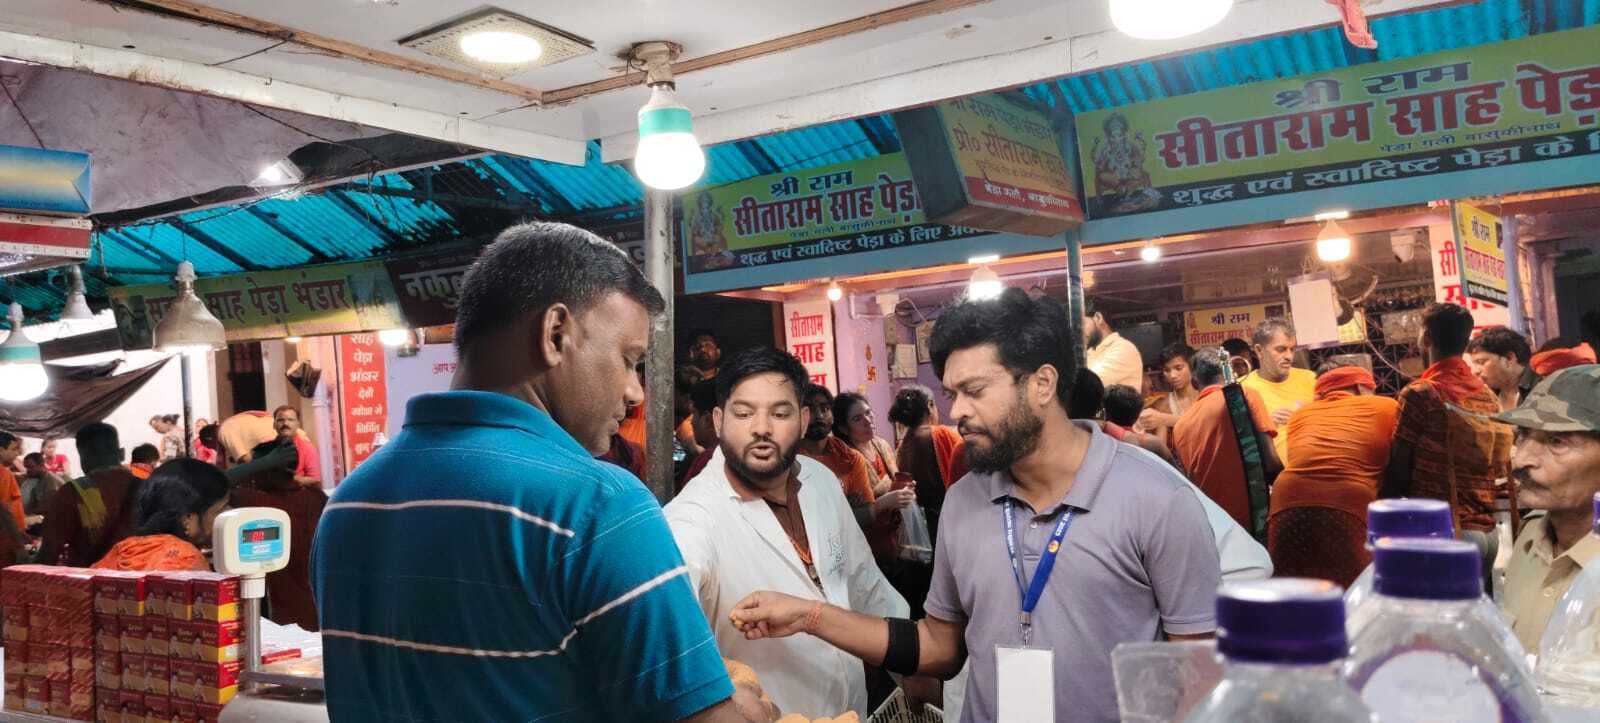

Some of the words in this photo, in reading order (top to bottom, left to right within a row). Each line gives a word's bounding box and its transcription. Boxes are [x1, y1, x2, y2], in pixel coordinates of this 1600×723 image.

[1274, 79, 1343, 108] श्री
[1361, 61, 1472, 95] राम
[1155, 102, 1374, 169] सीताराम
[1386, 81, 1505, 136] साह
[770, 176, 799, 198] श्री
[809, 170, 854, 191] राम
[1173, 183, 1234, 207] शुद्ध
[1246, 171, 1294, 194] एवं
[1303, 158, 1440, 188] स्वादिष्ट
[1453, 144, 1522, 168] पेड़ा
[1533, 135, 1575, 157] के
[732, 195, 823, 236] सीताराम
[828, 186, 875, 222] साह
[772, 244, 793, 260] एवं
[857, 233, 884, 250] पेड़ा
[889, 230, 905, 245] के
[910, 224, 942, 243] लिए
[248, 276, 290, 324] पेड़ा
[292, 270, 353, 311] भंडार
[790, 311, 824, 338] सीताराम
[792, 342, 825, 364] साह
